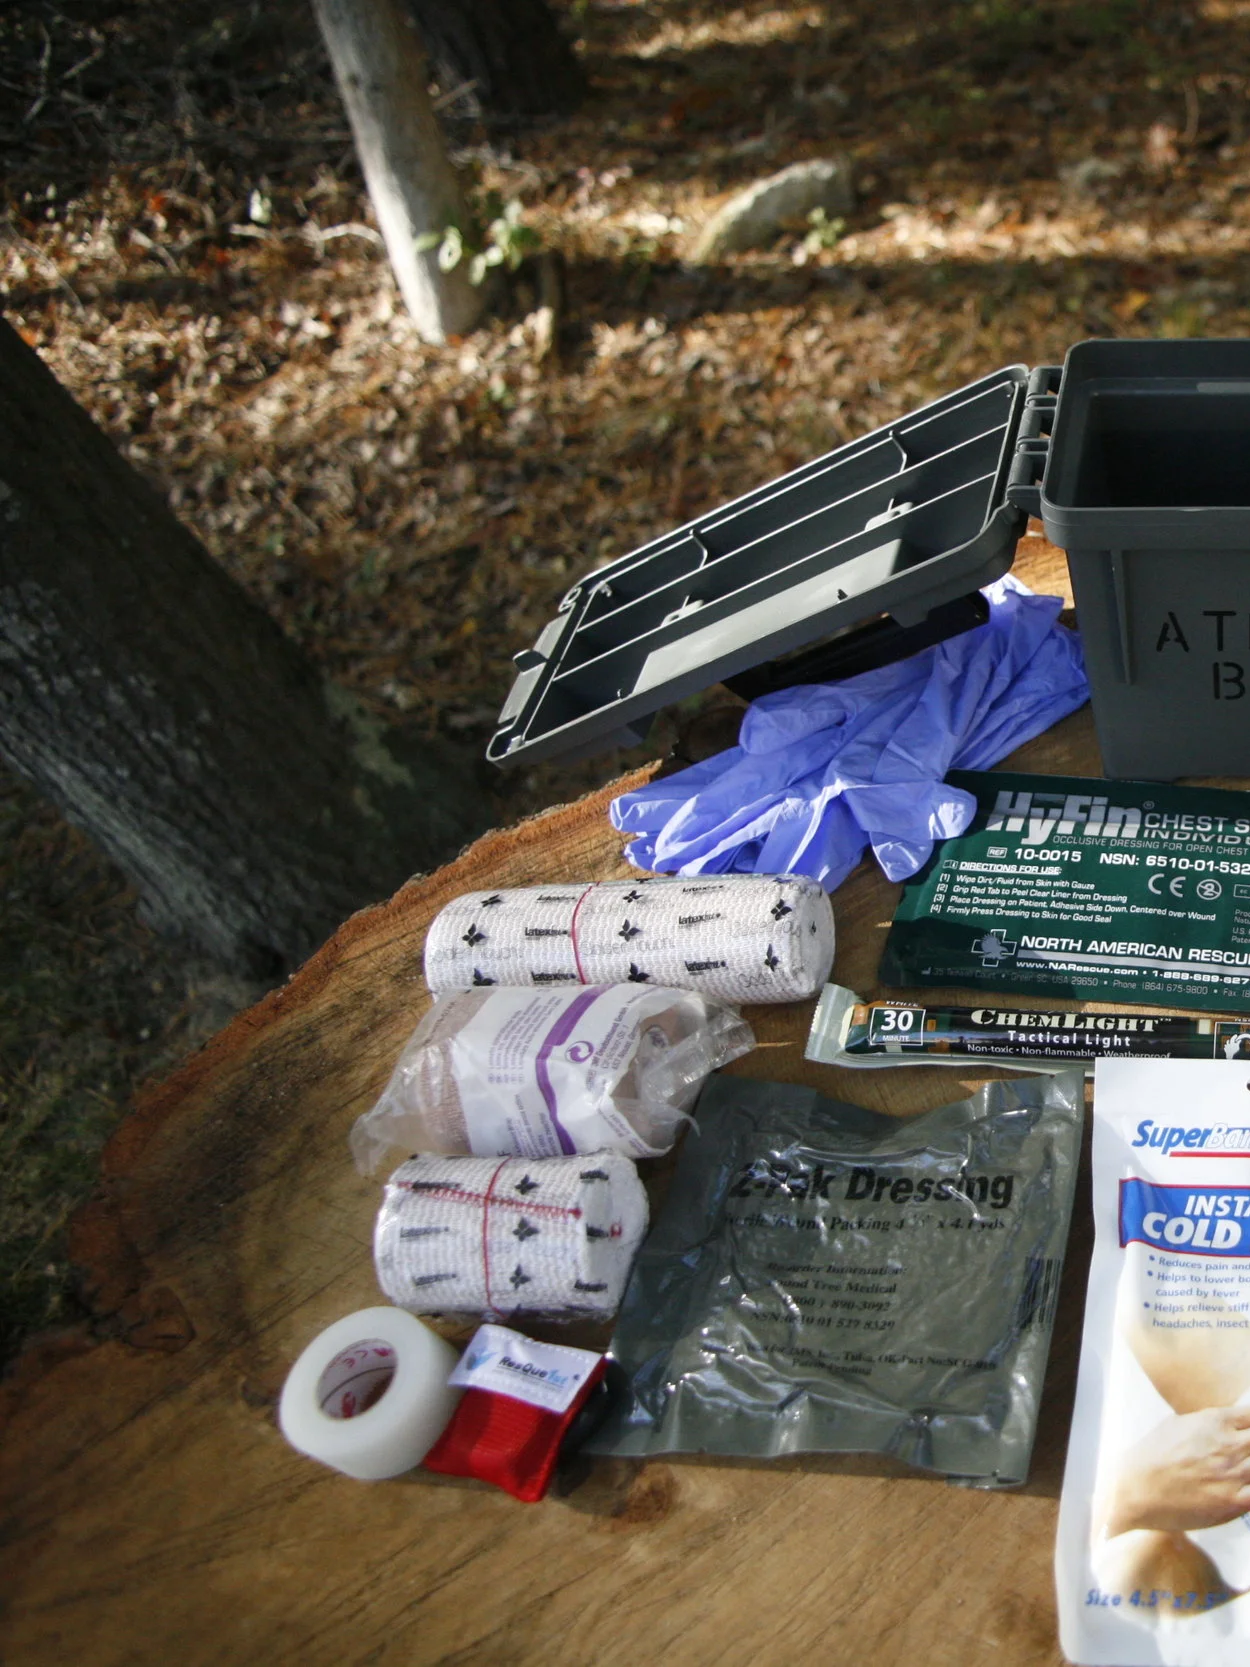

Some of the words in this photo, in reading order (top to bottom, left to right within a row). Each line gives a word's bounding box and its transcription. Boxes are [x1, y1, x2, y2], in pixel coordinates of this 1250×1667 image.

[985, 790, 1142, 845] HyFin
[1144, 812, 1229, 832] CHEST
[1053, 835, 1107, 847] OCCLUSIVE
[1109, 839, 1160, 850] DRESSING
[1163, 842, 1183, 851] FOR
[1186, 844, 1213, 853] OPEN
[1216, 846, 1249, 856] CHEST
[1014, 848, 1082, 863] 10-0015
[1099, 852, 1140, 866] NSN:
[960, 861, 1018, 874] DIRECTIONS
[1019, 864, 1039, 874] FOR
[1040, 865, 1062, 875] USE:
[956, 874, 976, 884] Wipe
[977, 875, 1014, 886] Dirt/Fluid
[1015, 878, 1034, 886] from
[1035, 878, 1052, 887] Skin
[1053, 879, 1070, 887] with
[1071, 880, 1095, 890] Gauze
[952, 884, 969, 894] Grip
[970, 886, 986, 894] Red
[987, 886, 1000, 895] Tab
[1011, 888, 1028, 896] Peel
[1029, 889, 1050, 898] Clear
[1051, 890, 1071, 898] Liner
[1072, 892, 1091, 900] from
[1093, 892, 1127, 904] Dressing
[946, 905, 970, 916] Firmly
[971, 906, 994, 915] Press
[995, 907, 1030, 919] Dressing
[1041, 911, 1058, 919] Skin
[1059, 911, 1071, 920] for
[1072, 912, 1093, 922] Good
[1094, 914, 1112, 923] Seal
[950, 895, 971, 904] Place
[971, 896, 1006, 907] Dressing
[1050, 900, 1084, 911] Adhesive
[1086, 903, 1103, 912] Side
[1130, 905, 1167, 915] Centered
[1168, 909, 1186, 918] over
[1187, 911, 1216, 921] Wound
[1020, 935, 1085, 951] NORTH
[1086, 940, 1183, 960] AMERICAN
[1016, 960, 1139, 976] www.NARescue.com
[1071, 976, 1098, 986] 29650
[1112, 979, 1137, 990] Phone
[1166, 983, 1208, 995] 675-9800
[880, 1010, 914, 1032] 30
[882, 1034, 910, 1042] MINUTE
[1008, 1030, 1077, 1044] Tactical
[1085, 1033, 1131, 1048] Light
[967, 1043, 1014, 1054] Non-toxic
[1021, 1046, 1096, 1058] Non-flammable
[845, 1162, 1015, 1209] Dressing
[1142, 1211, 1243, 1250] COLD
[1158, 1257, 1202, 1269] Reduces
[1205, 1262, 1229, 1272] pain
[1231, 1261, 1250, 1270] and
[1157, 1272, 1187, 1283] Helps
[1190, 1274, 1201, 1283] to
[1204, 1274, 1234, 1283] lower
[1155, 1288, 1193, 1297] caused
[1196, 1288, 1209, 1299] by
[1212, 1289, 1240, 1297] fever
[1154, 1303, 1185, 1313] Helps
[1187, 1303, 1225, 1312] relieve
[1227, 1303, 1250, 1312] stiff
[1152, 1318, 1212, 1329] headaches,
[1216, 1319, 1249, 1329] insect
[1084, 1588, 1122, 1607] Size
